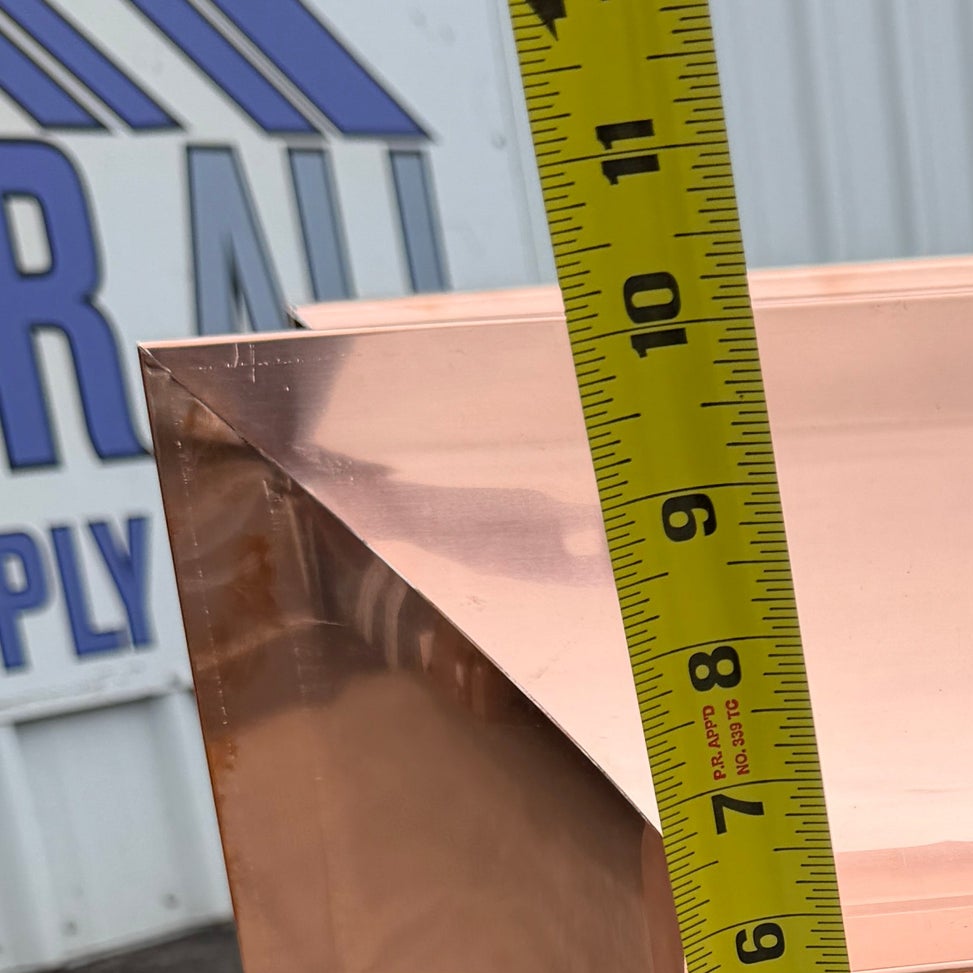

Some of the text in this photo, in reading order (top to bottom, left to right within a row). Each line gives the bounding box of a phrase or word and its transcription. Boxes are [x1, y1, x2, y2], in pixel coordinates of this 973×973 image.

[595, 118, 661, 186] 11
[623, 271, 688, 359] 10
[660, 493, 718, 543] 9
[0, 517, 154, 671] PLY
[688, 645, 742, 693] 8
[725, 698, 750, 776] NO. 339 TC
[711, 793, 765, 835] 7
[735, 922, 786, 965] 6
